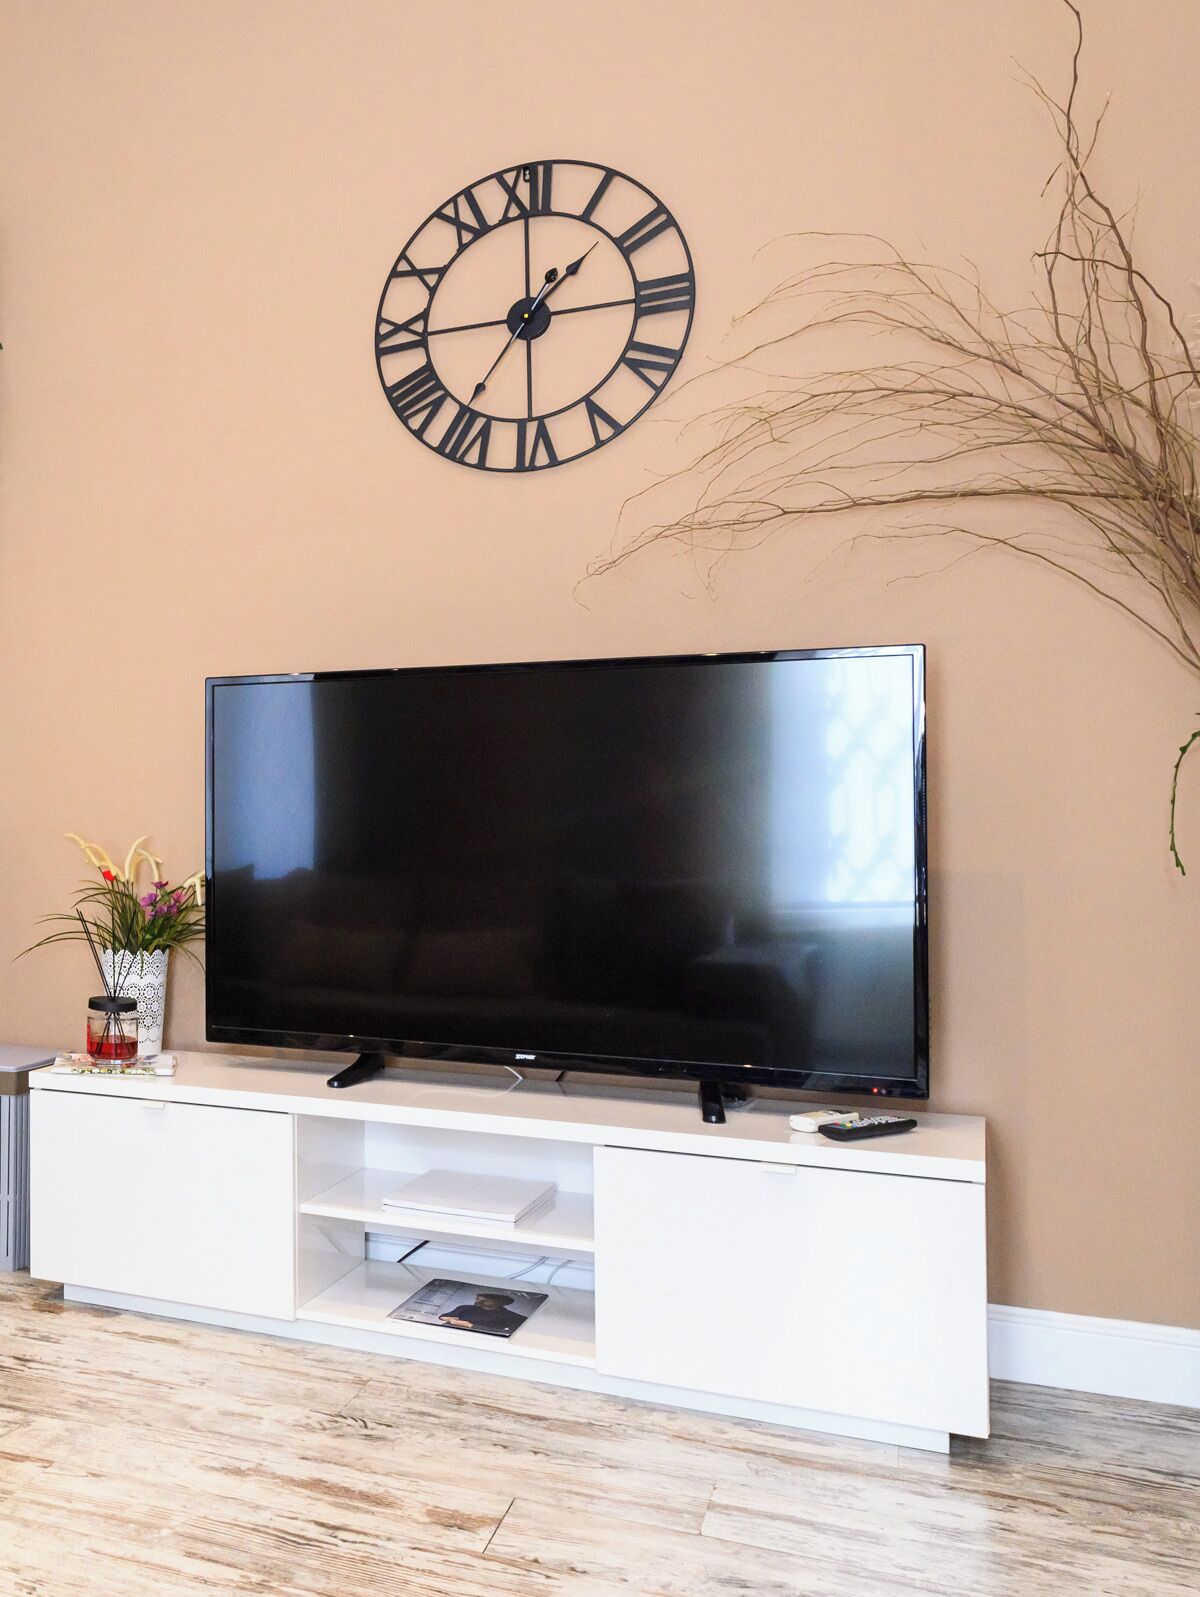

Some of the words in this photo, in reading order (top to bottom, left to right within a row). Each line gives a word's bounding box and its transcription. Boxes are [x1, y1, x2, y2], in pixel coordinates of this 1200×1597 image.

[496, 160, 551, 219] XII
[581, 168, 615, 218] I
[432, 187, 493, 250] XI
[615, 204, 676, 256] II
[391, 252, 449, 294] X
[635, 272, 693, 317] III
[377, 309, 428, 357] IX
[623, 341, 682, 393] IV
[387, 363, 449, 437] VIII
[584, 398, 623, 447] V
[438, 407, 492, 468] VII
[516, 417, 558, 469] VI
